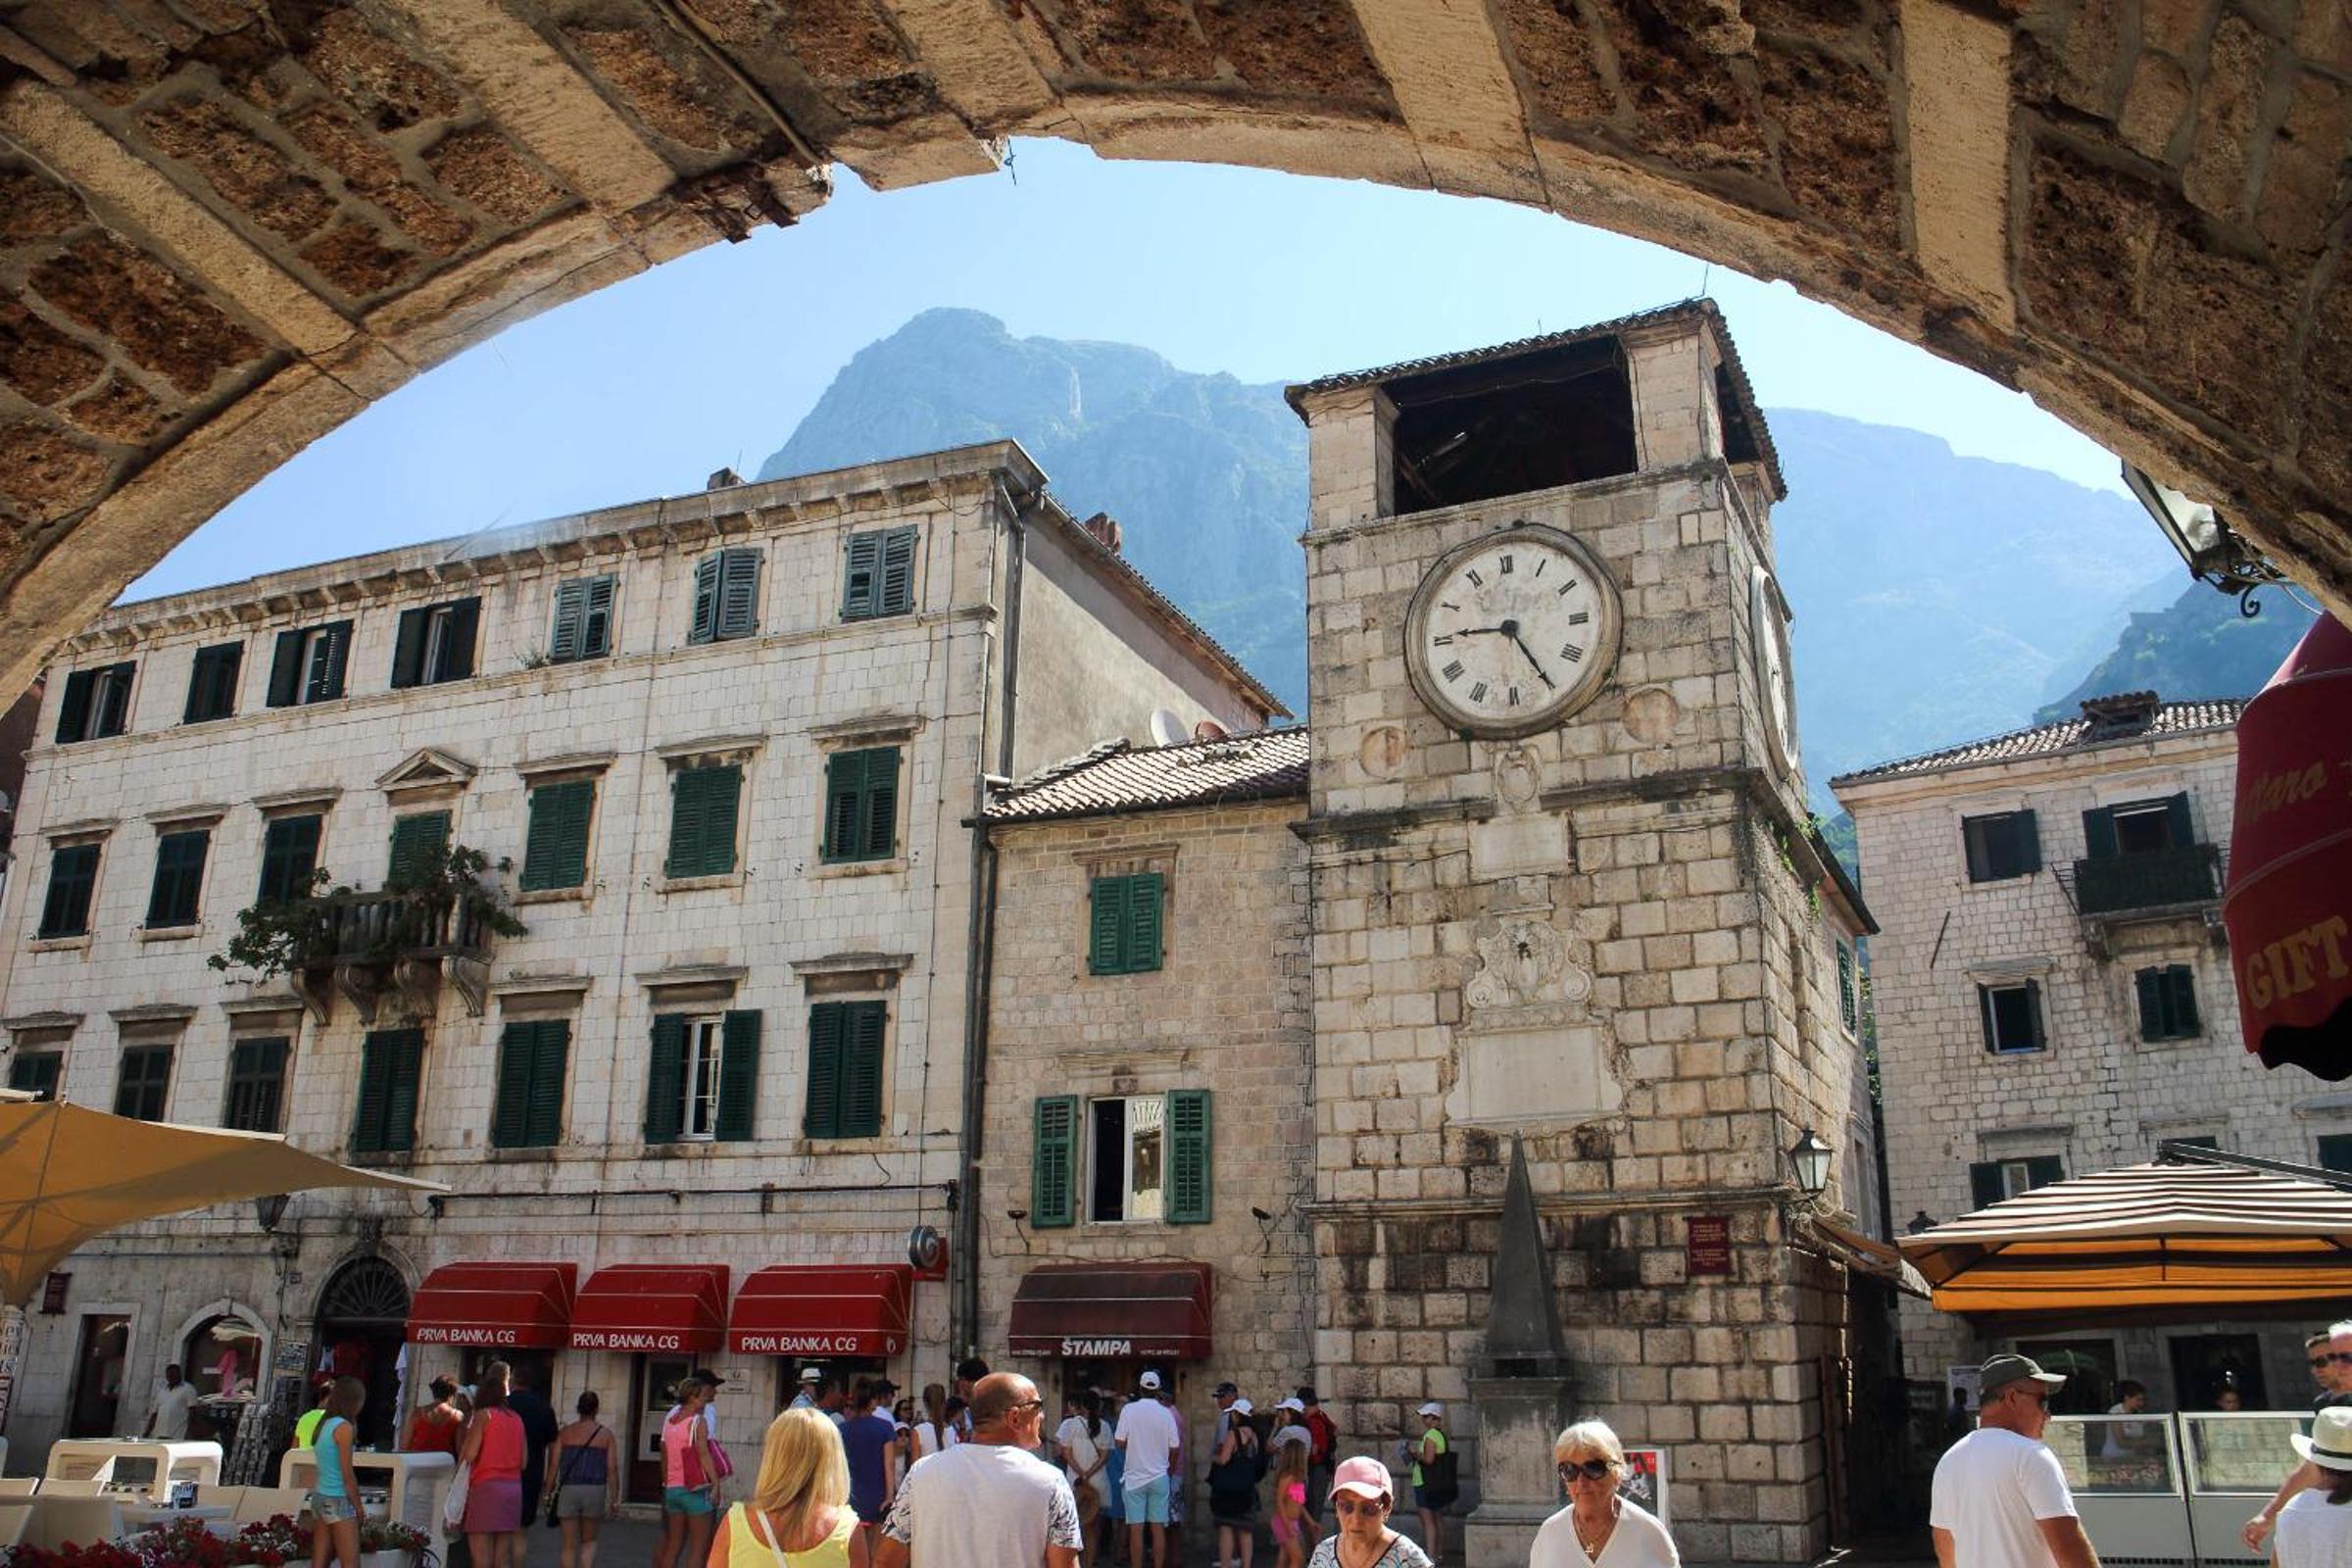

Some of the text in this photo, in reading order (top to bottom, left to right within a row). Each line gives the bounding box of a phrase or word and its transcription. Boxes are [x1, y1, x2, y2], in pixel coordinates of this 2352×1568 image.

[1499, 555, 1514, 575] XII
[1535, 559, 1546, 577] I
[1465, 568, 1484, 589] XI
[1558, 579, 1577, 596] II
[1568, 612, 1590, 625] III
[1434, 635, 1453, 647] IX
[1508, 687, 1520, 707] VI
[2246, 914, 2349, 1010] GIFT
[416, 1328, 515, 1343] PRVA BANKA CG
[572, 1333, 679, 1348] PRVA BANKA CG
[742, 1337, 858, 1350] PRVA BANKA CG
[1061, 1337, 1131, 1355] ŠTAMPA
